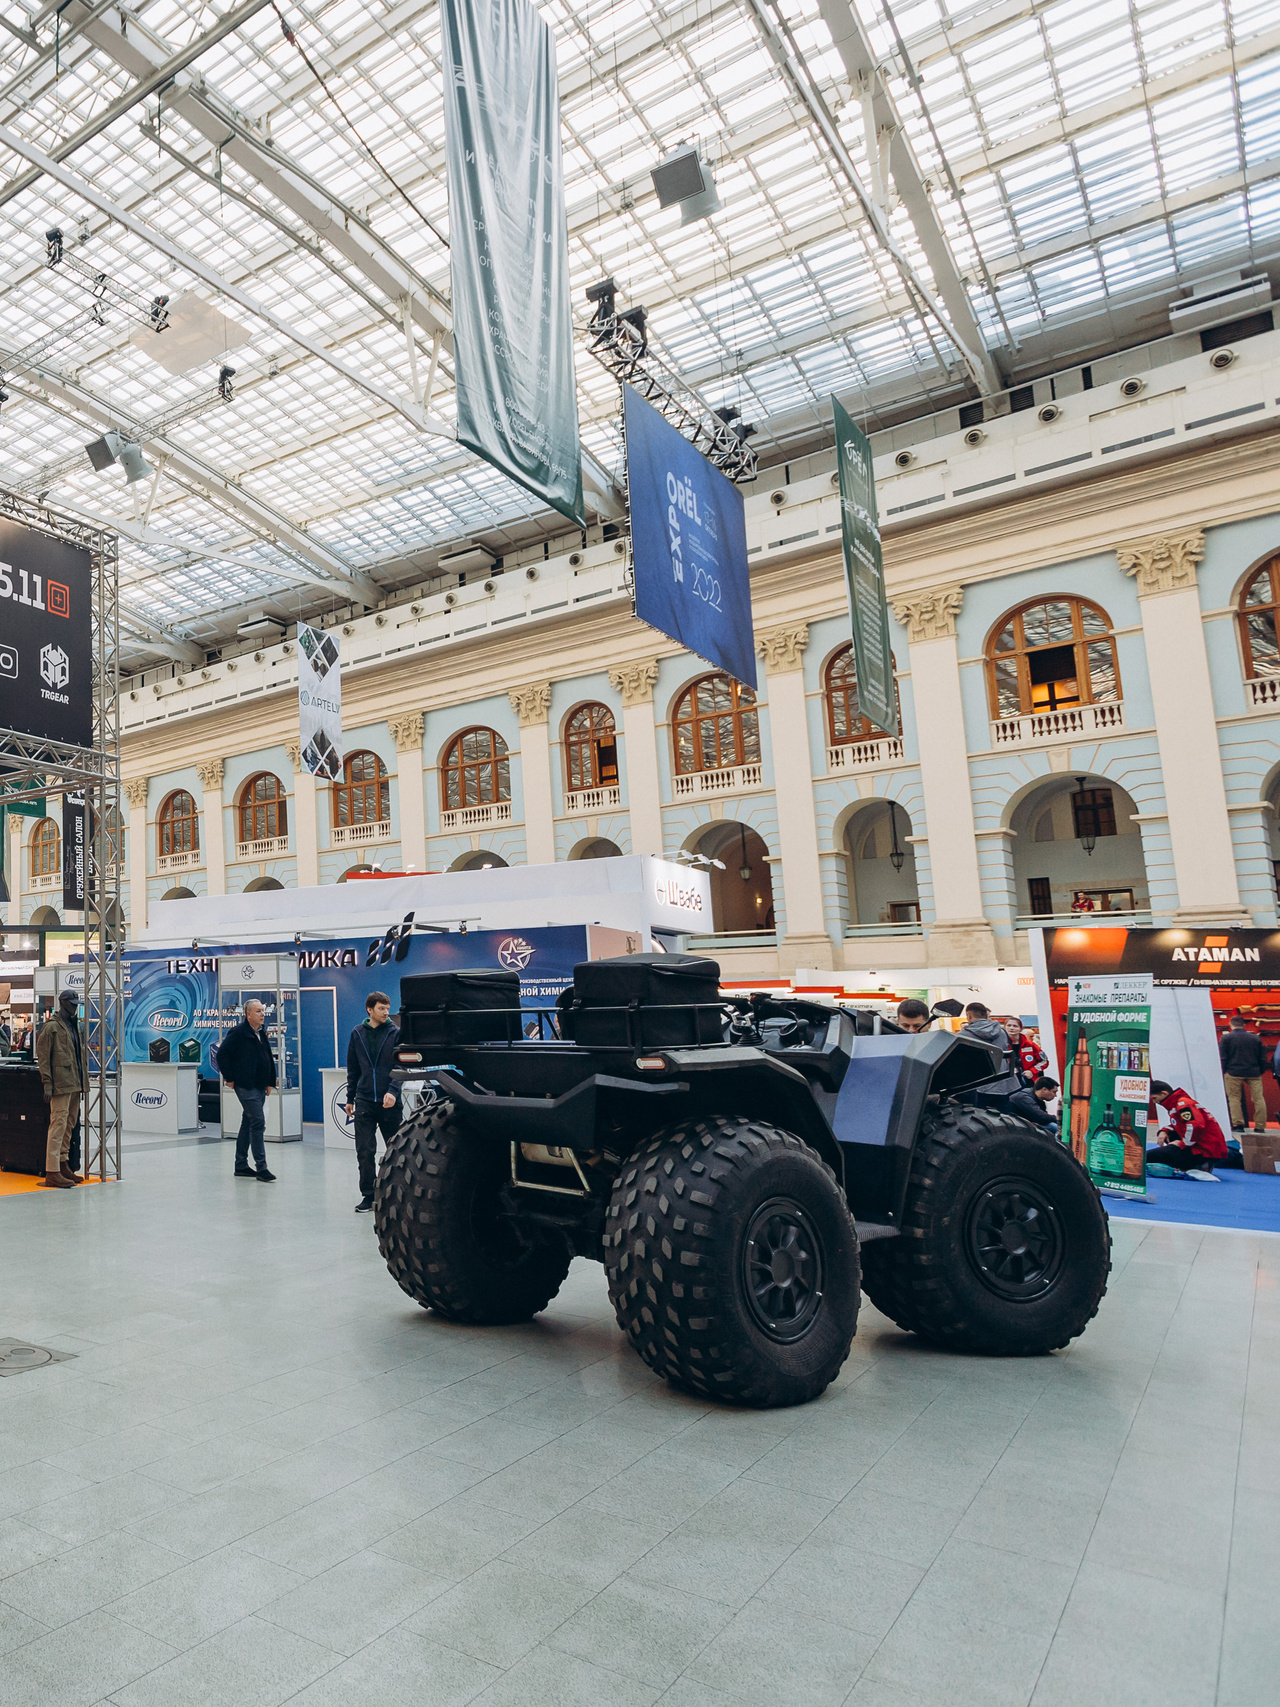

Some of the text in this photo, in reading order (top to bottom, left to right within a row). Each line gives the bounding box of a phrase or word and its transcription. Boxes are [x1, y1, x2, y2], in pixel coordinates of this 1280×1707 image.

[40, 689, 70, 704] TRGEAR
[75, 816, 83, 843] САЛОН
[75, 846, 84, 899] ОРУЖЕЙНЫЙ
[1171, 947, 1260, 962] ATAMAN
[1075, 993, 1148, 1003] ЗНАКОМЫЕ ПРЕПАРАТЫ
[193, 1009, 202, 1017] АО
[1073, 1010, 1148, 1023] В УДОБНОЙ ФОРМЕ
[153, 1014, 183, 1027] Record
[1120, 1079, 1147, 1091] УДОБНОЕ
[135, 1092, 164, 1105] Record
